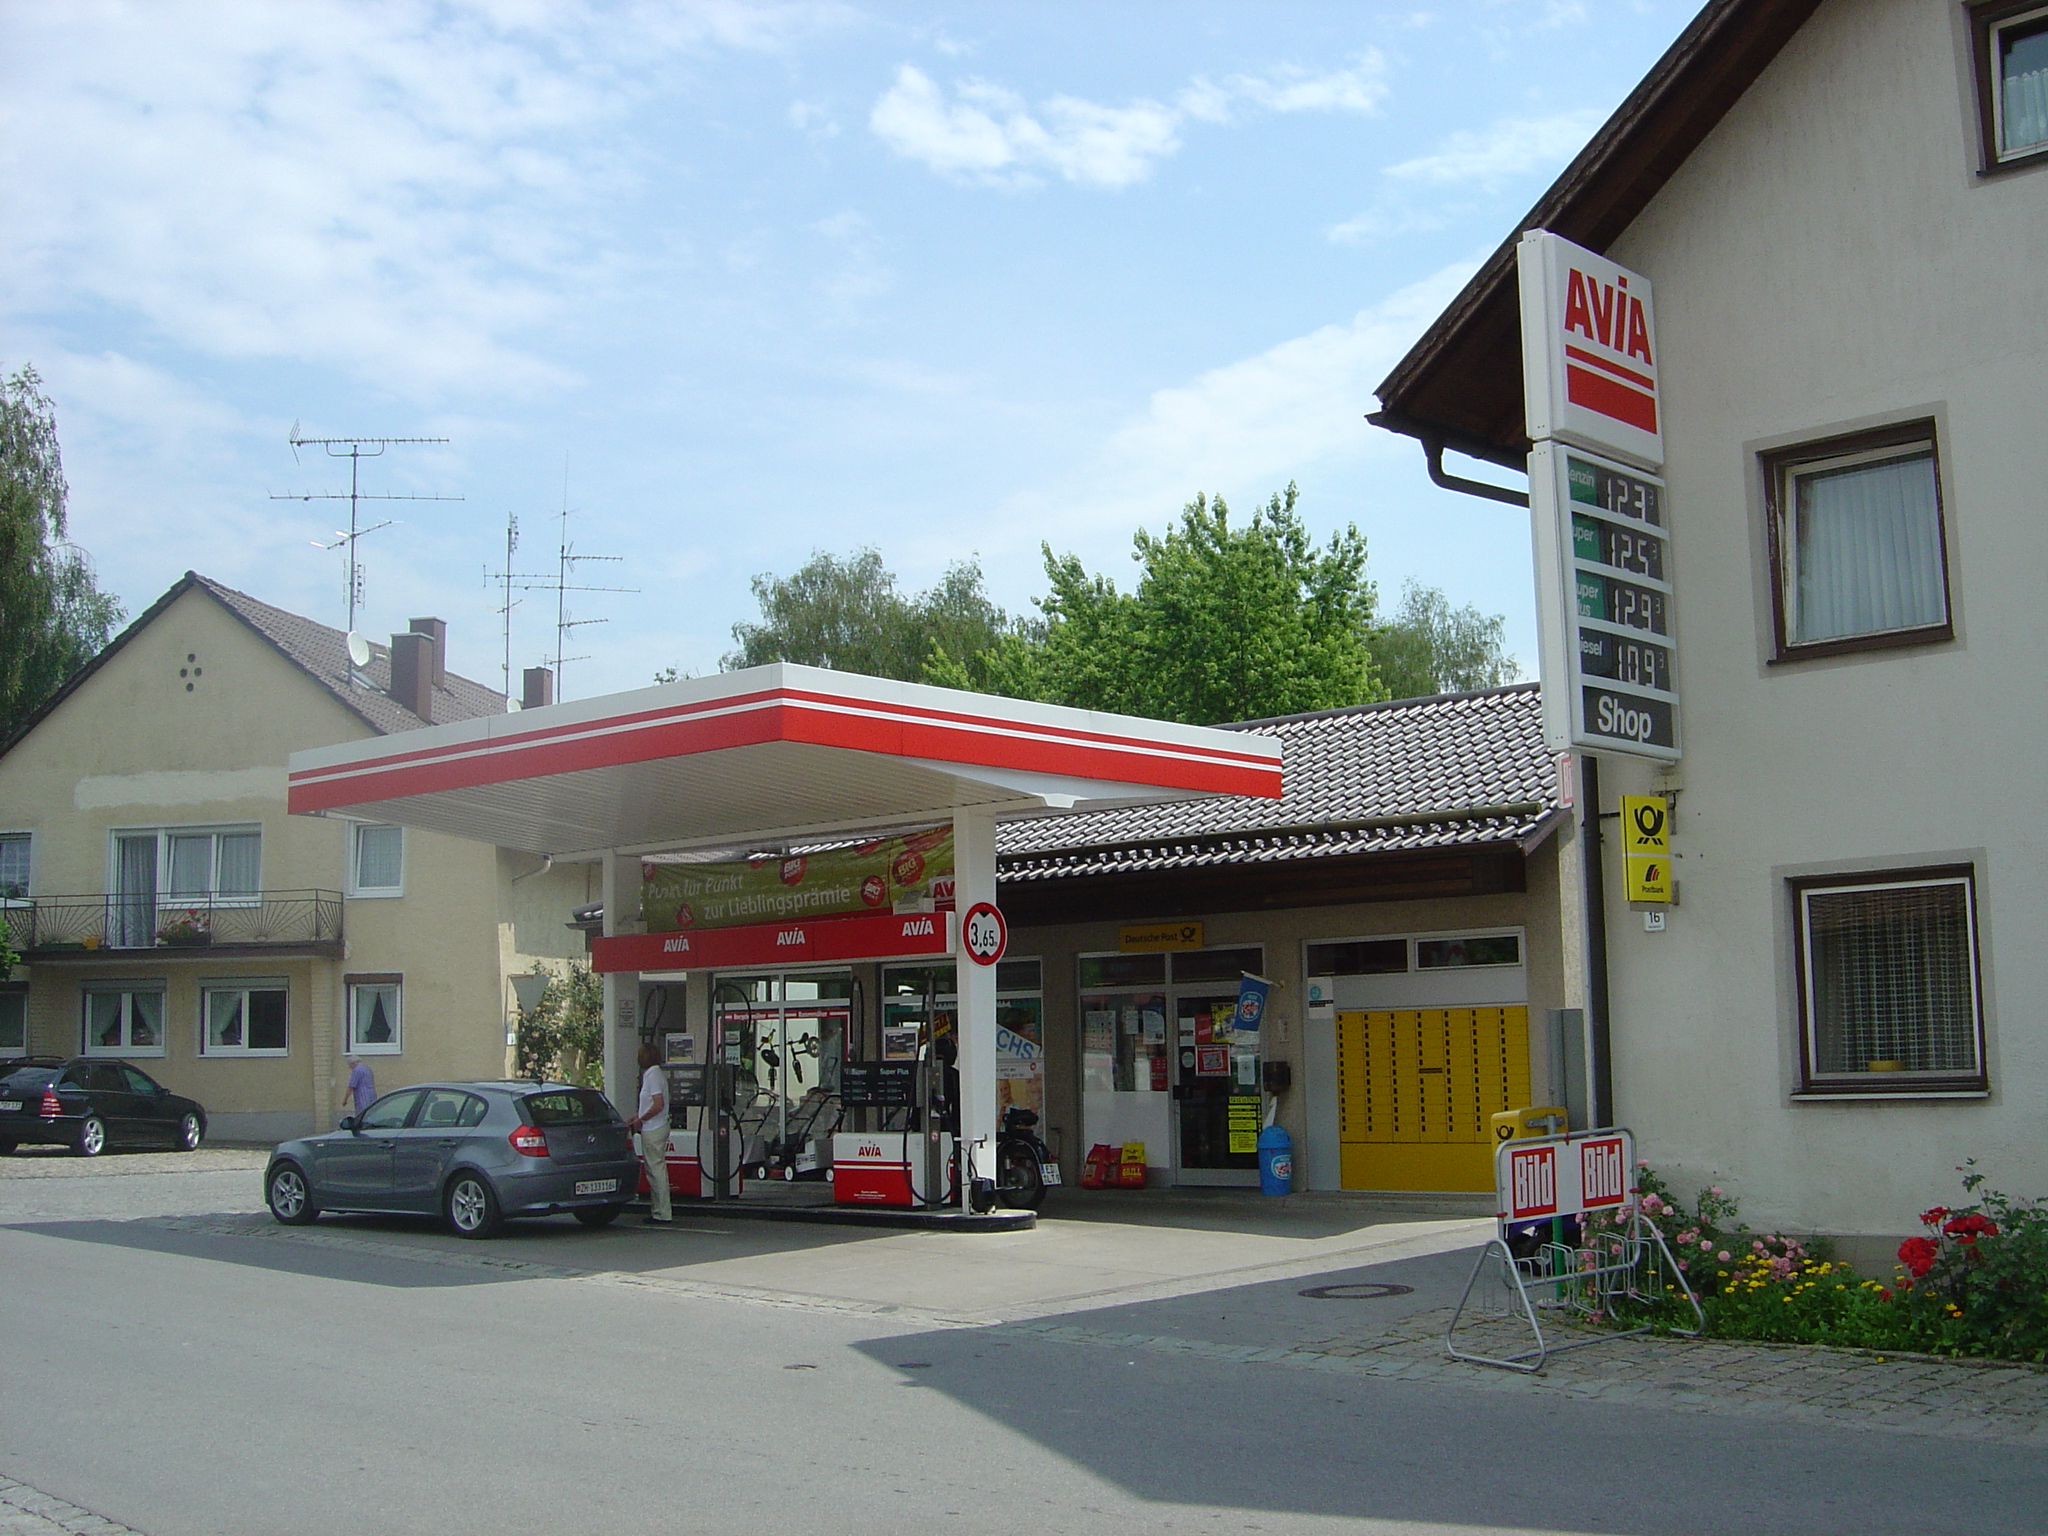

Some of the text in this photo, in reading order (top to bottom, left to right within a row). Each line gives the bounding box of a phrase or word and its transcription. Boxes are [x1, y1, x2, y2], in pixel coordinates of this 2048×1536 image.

[1569, 468, 1595, 488] enzin
[1573, 526, 1594, 542] uper
[1577, 584, 1599, 599] uper
[1597, 695, 1652, 744] Shop
[705, 874, 744, 894] Punkt
[1641, 885, 1664, 893] Postbank
[704, 904, 724, 920] zur
[729, 886, 851, 917] Lieblingsprämie
[1649, 912, 1660, 923] 16
[971, 922, 994, 947] 3,65
[1125, 932, 1177, 943] Deutsche Post
[1514, 1143, 1623, 1210] Bild Bild
